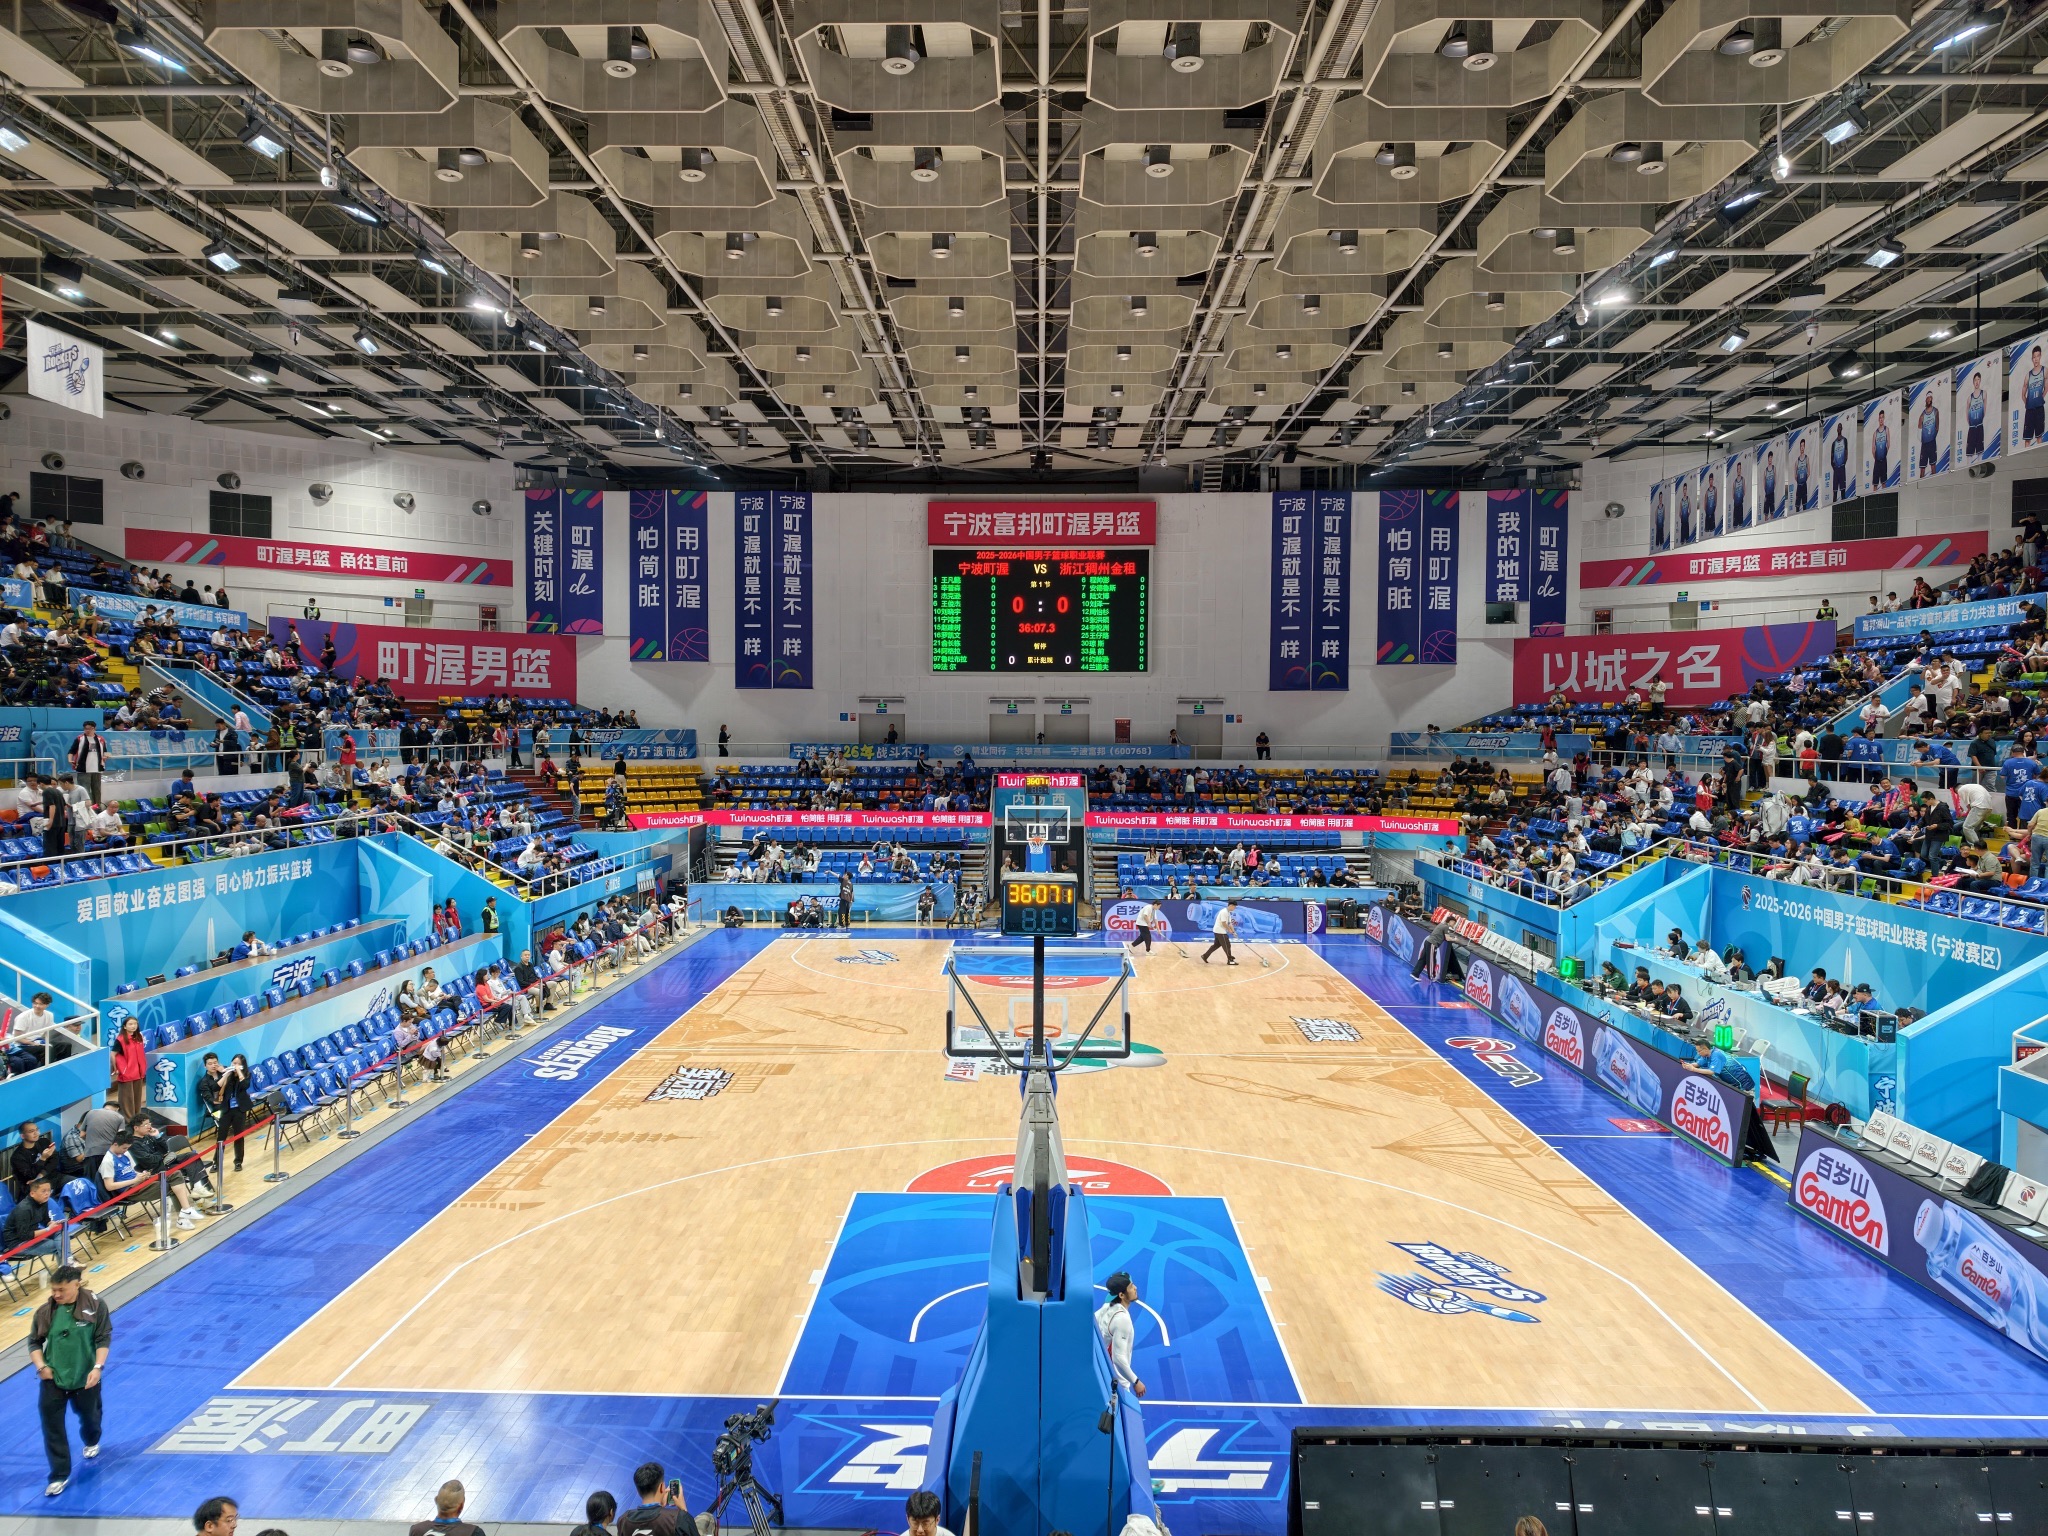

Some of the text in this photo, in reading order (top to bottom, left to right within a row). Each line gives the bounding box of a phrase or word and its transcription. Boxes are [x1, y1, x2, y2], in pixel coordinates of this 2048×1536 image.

[739, 497, 764, 511] 宁波
[780, 495, 806, 510] 宁波
[1280, 498, 1306, 512] 宁波
[1320, 497, 1345, 512] 宁波
[944, 511, 1140, 536] 宁波富邦町渥男篮
[257, 546, 408, 573] 町渥男篮 甬往直前
[533, 511, 553, 602] 关键时刻
[569, 526, 595, 595] 町渥 de
[637, 526, 660, 608] 怕筒脏
[676, 527, 701, 608] 用町渥
[958, 562, 1136, 575] 宁波町渥 VS 浙江稠州金租
[1387, 527, 1413, 610] 怕筒脏
[1429, 527, 1451, 610] 用町渥
[1537, 527, 1560, 598] 町渥 de
[1689, 549, 1848, 575] 町渥男篮 甬往直前
[743, 514, 762, 657] 町渥就是不一样
[783, 513, 802, 657] 町渥就是不一样
[1281, 515, 1302, 659] 町渥就是不一样
[1322, 515, 1341, 659] 町渥就是不一样
[1012, 597, 1024, 613] 0
[1057, 597, 1069, 613] 0
[1961, 605, 1996, 621] 合力共进
[1019, 623, 1056, 633] 36:07.3
[377, 642, 551, 688] 町渥男篮
[1008, 656, 1015, 665] 0
[1065, 656, 1072, 665] 0
[1543, 644, 1721, 694] 以城之名
[628, 745, 688, 758] 为宁波而战
[1467, 736, 1510, 749] ROCKETS
[646, 815, 703, 826] Twinwash町渥
[729, 813, 983, 824] Twinwash町渥 怕筒脏 用町渥 Twinwash町渥 怕筒脏 用町渥
[1094, 815, 1439, 831] Twinwash町渥 怕筒脏 用町渥 Twinwash町渥 怕筒脏 用町渥 Twinwash町渥
[77, 858, 313, 924] 爱国敬业奋发图强 同心协力振兴篮球
[1367, 919, 1382, 942] Ganten
[1755, 892, 1812, 921] 2025-2026
[1813, 907, 1927, 953] 中国男子篮球职业联赛
[272, 957, 315, 991] 宁波
[1472, 963, 1490, 983] 百岁山
[1466, 975, 1492, 1008] Ganten
[1554, 1011, 1578, 1037] 百岁山
[533, 1026, 635, 1081] ROCKETS
[539, 1040, 575, 1060] NINGBO
[1546, 1024, 1583, 1066] Ganten
[154, 1058, 178, 1103] 宁波
[1473, 1052, 1543, 1088] CBA
[1611, 1059, 1628, 1084] Ganten
[1685, 1080, 1720, 1116] 百岁山
[1673, 1097, 1729, 1154] Ganten
[1868, 1124, 1886, 1139] Ganten
[1893, 1136, 1912, 1151] Ganten
[1918, 1147, 1938, 1164] Ganten
[1816, 1153, 1870, 1200] 百岁山
[1946, 1161, 1967, 1176] Ganten
[1800, 1172, 1883, 1249] Ganten
[1396, 1243, 1544, 1302] ROCKETS
[1981, 1249, 2004, 1274] 百岁山
[1961, 1258, 2002, 1302] Ganten
[155, 1397, 431, 1454] 町渥
